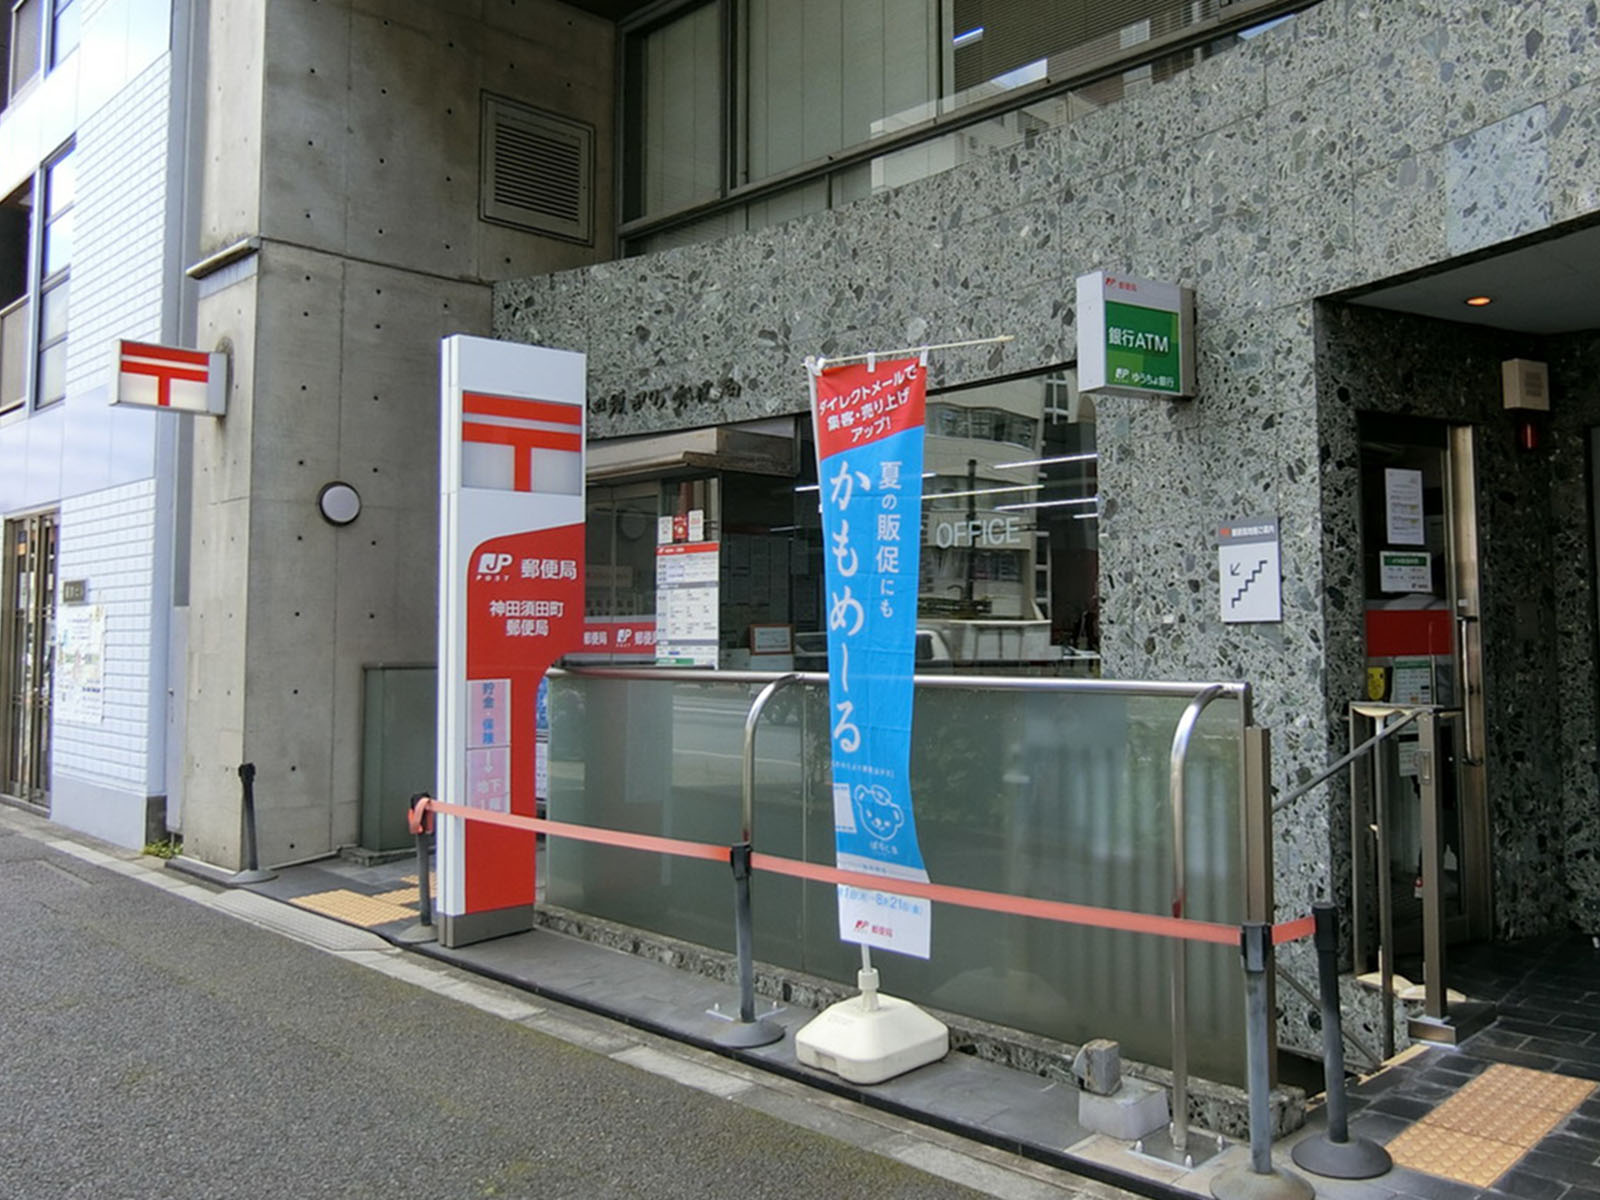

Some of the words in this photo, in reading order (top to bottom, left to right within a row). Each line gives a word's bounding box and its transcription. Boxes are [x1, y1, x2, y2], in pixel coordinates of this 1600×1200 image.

[1108, 327, 1168, 352] 銀行ATM
[819, 363, 918, 416] ダイレクトメールで
[1132, 372, 1174, 387] ゆうちょ銀行
[876, 461, 903, 618] 夏の販促にも
[935, 516, 1021, 549] OFFICE
[475, 574, 510, 582] POST
[521, 558, 578, 580] 郵便局
[489, 599, 564, 618] 神田須田町
[506, 618, 549, 637] 郵便局
[583, 631, 608, 646] 郵便局
